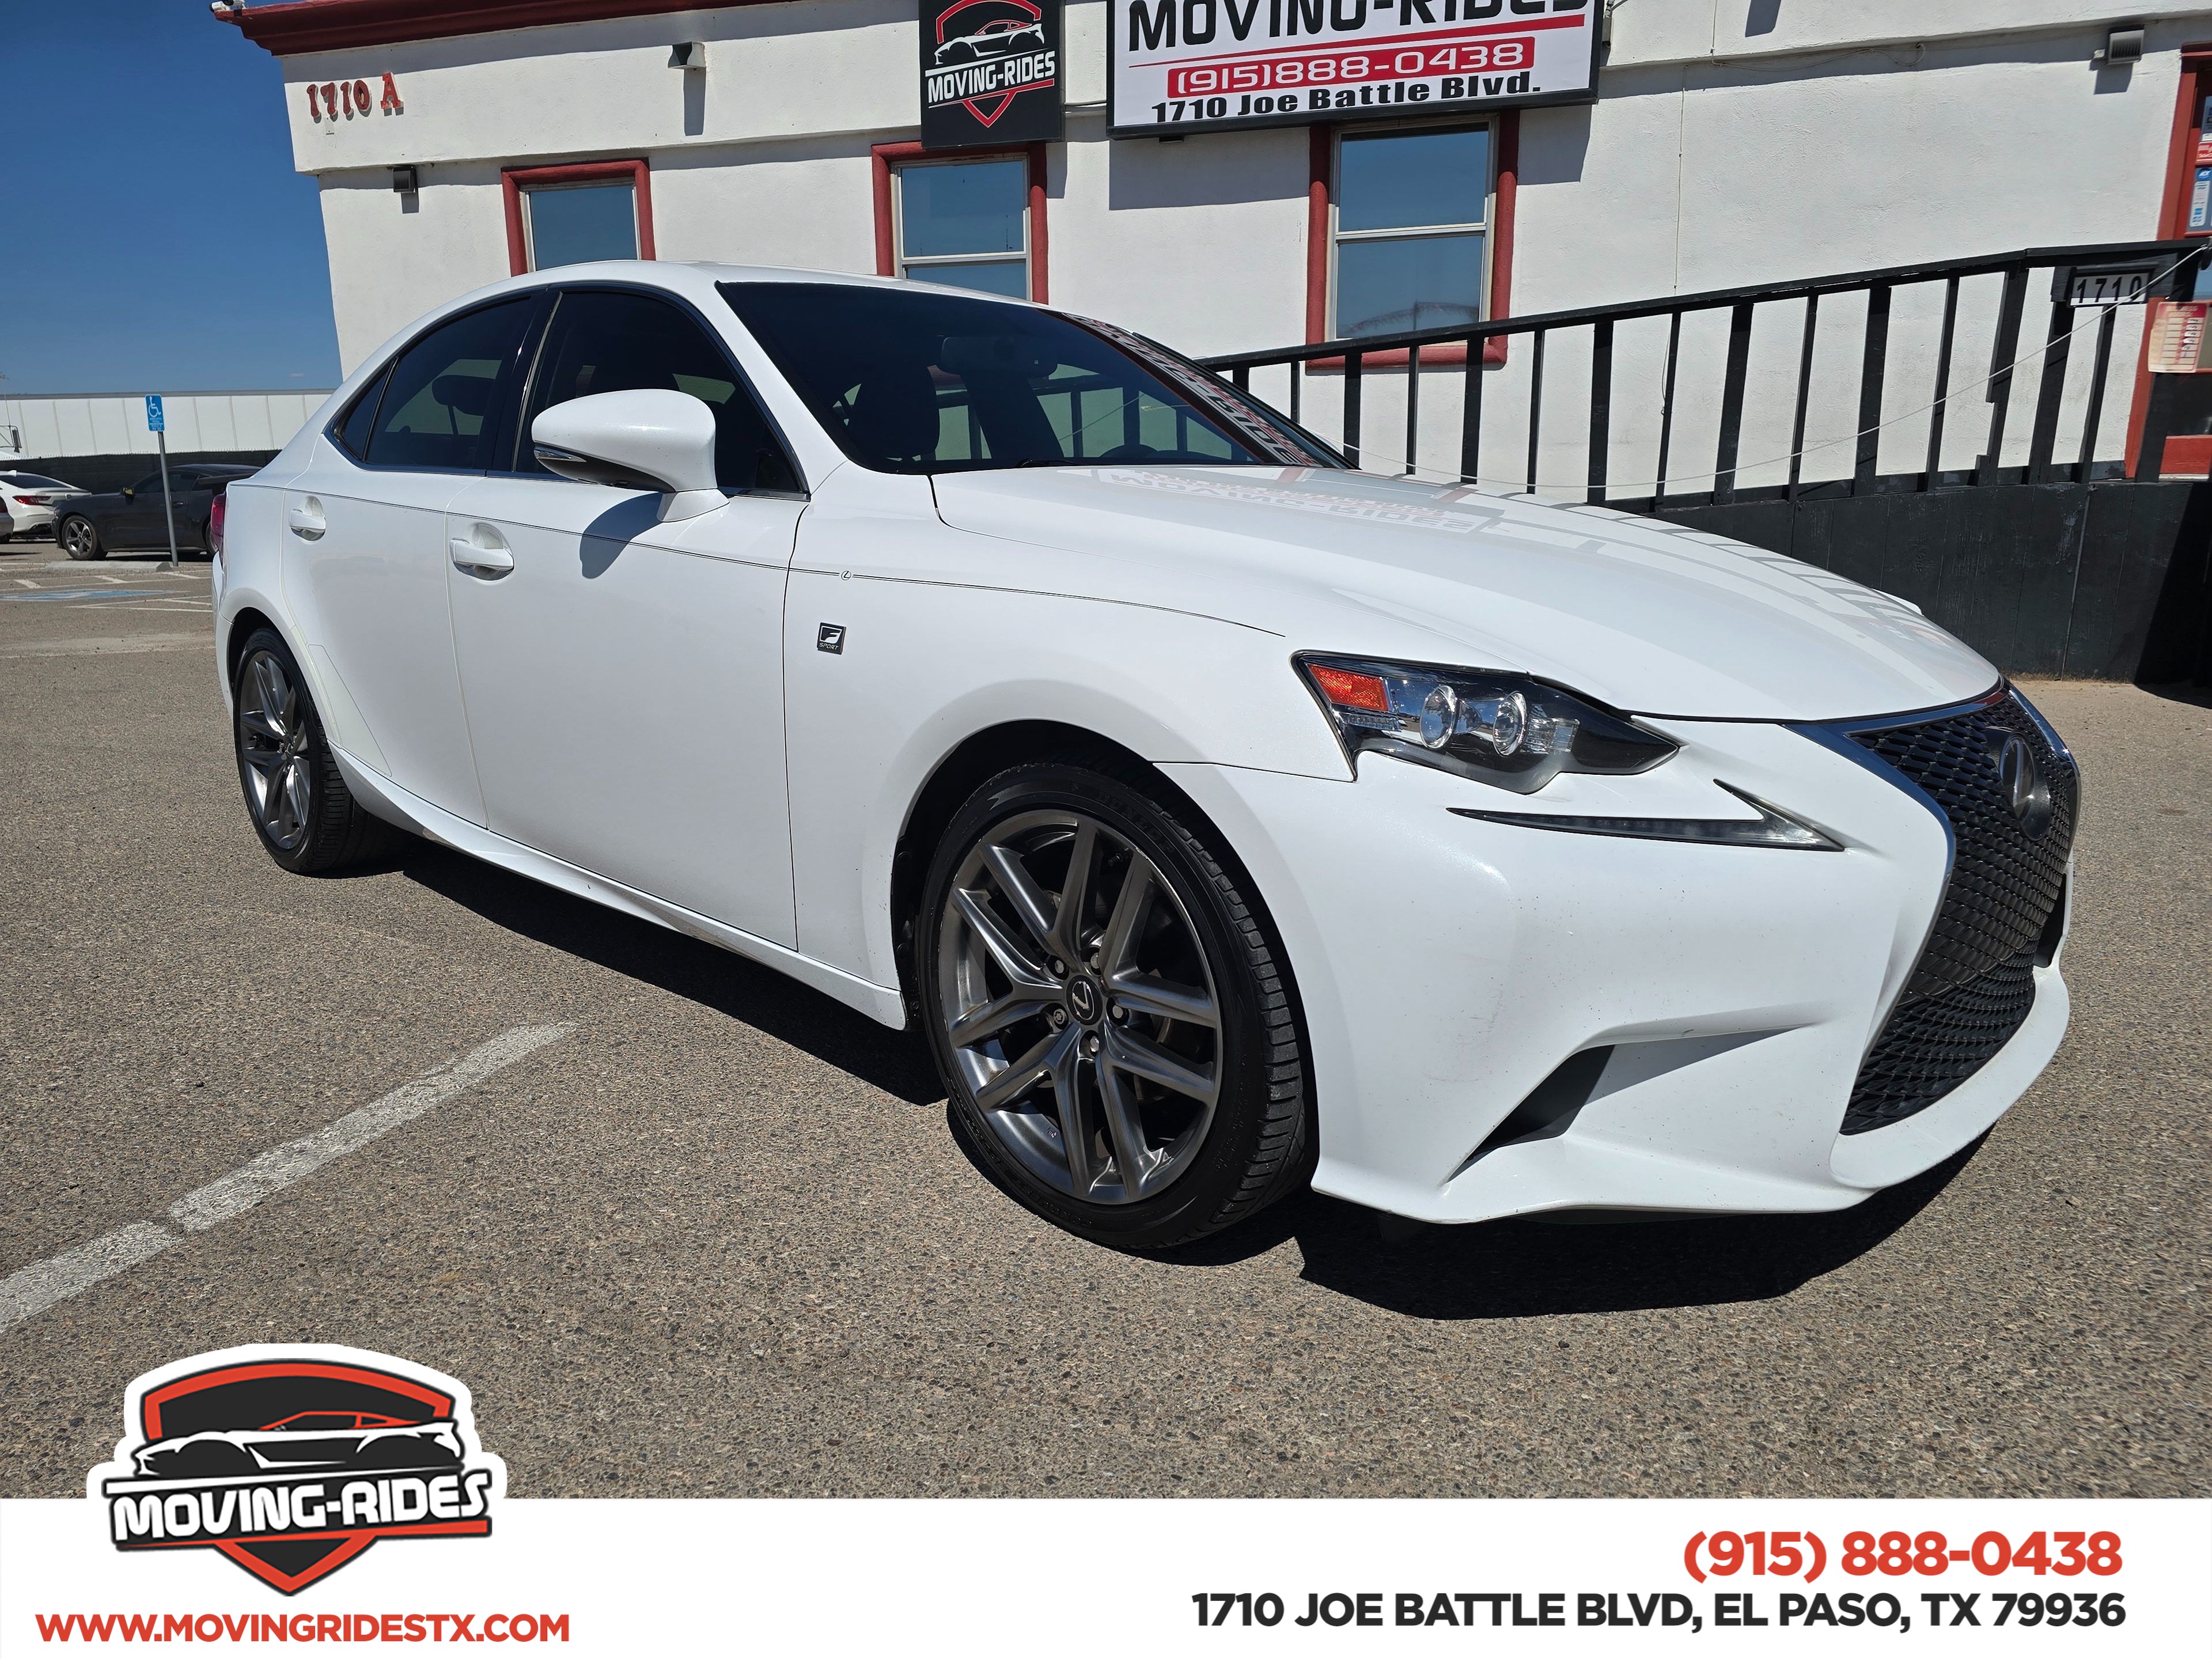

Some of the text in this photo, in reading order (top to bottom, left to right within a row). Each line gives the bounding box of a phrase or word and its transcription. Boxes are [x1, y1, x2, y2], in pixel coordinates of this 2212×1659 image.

[1129, 0, 1588, 51] MOVING-R
[928, 51, 1055, 103] MOVING-RIDES
[1177, 43, 1523, 93] (915)888-0438
[306, 71, 402, 118] 1710 A
[1152, 71, 1541, 123] 1710 Joe Battle Blvd.
[2076, 275, 2142, 304] 1710
[819, 642, 839, 650] SPORT
